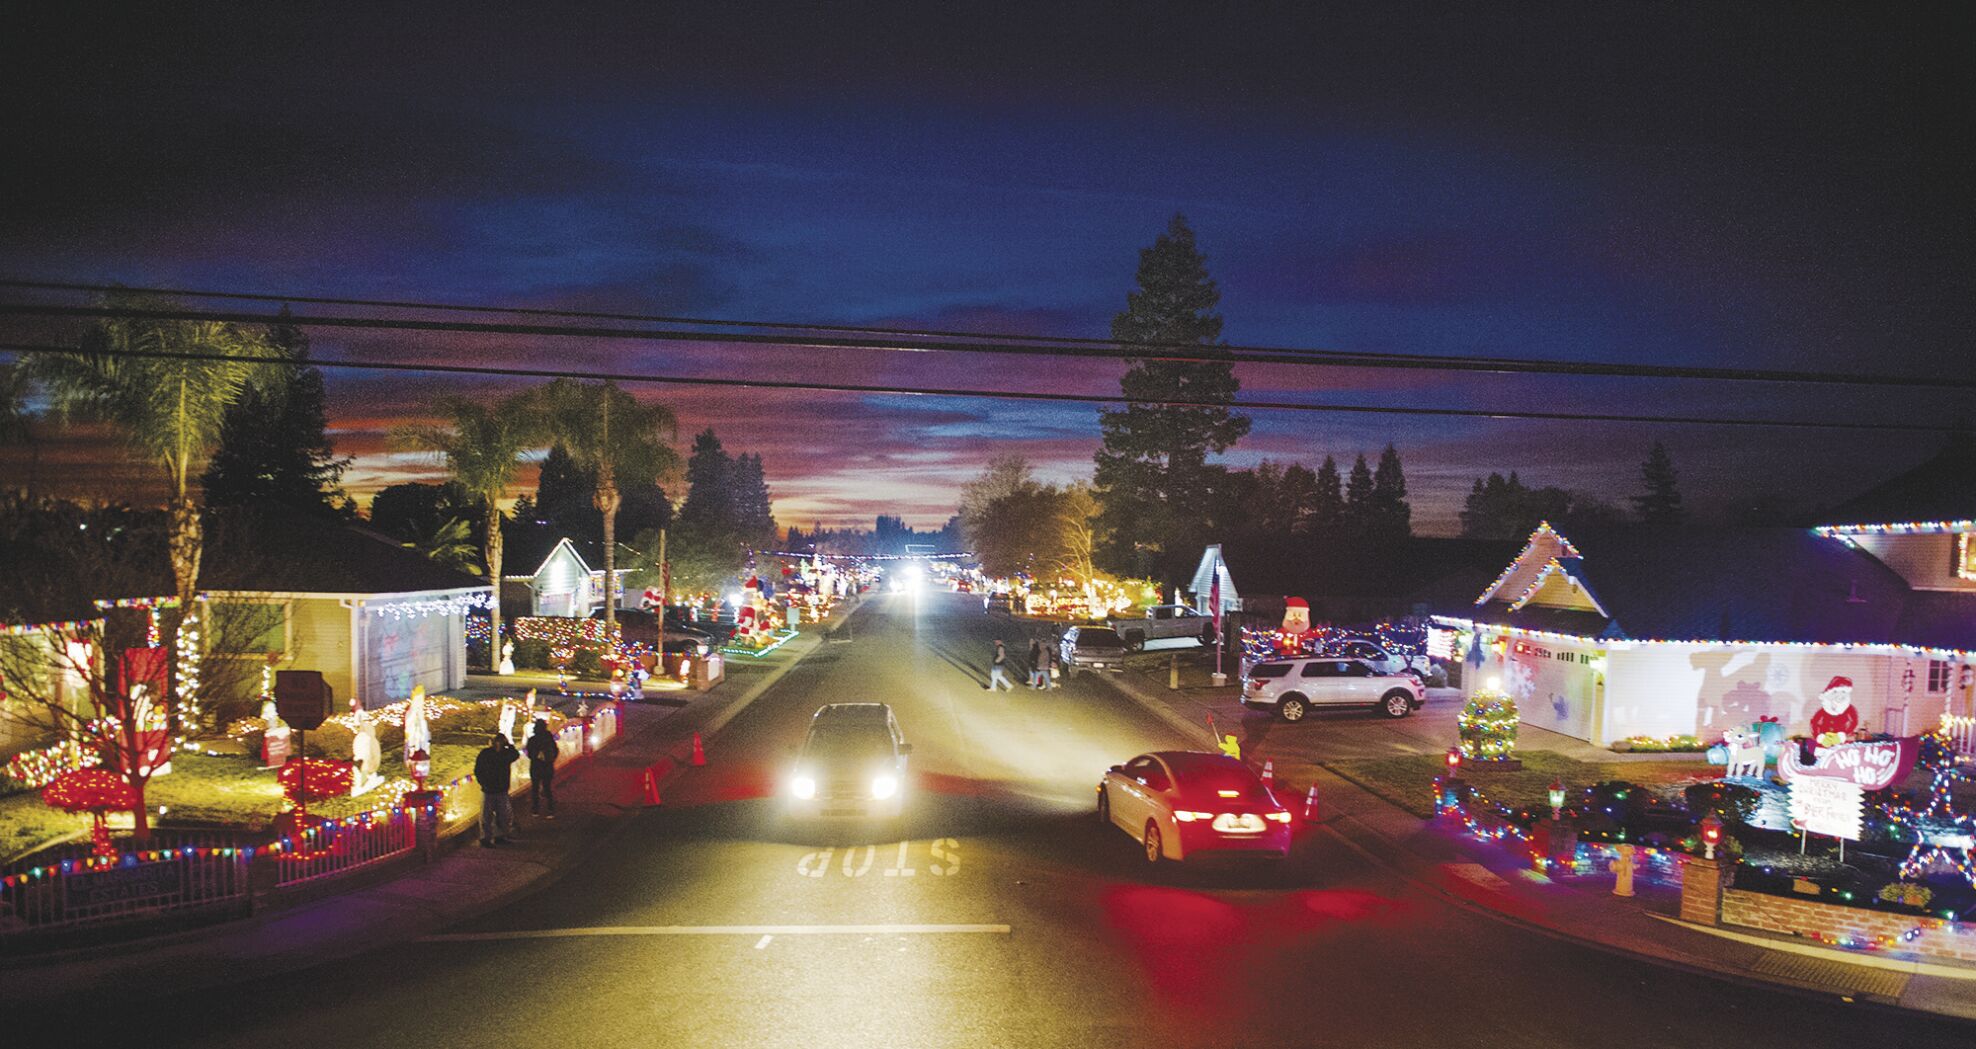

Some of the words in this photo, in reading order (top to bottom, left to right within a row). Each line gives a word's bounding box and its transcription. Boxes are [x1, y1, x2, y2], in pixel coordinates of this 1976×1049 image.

[1835, 748, 1860, 769] HO
[1864, 746, 1895, 766] HO
[1853, 766, 1877, 784] HO
[797, 838, 960, 877] STOP
[89, 880, 159, 902] ESTATES
